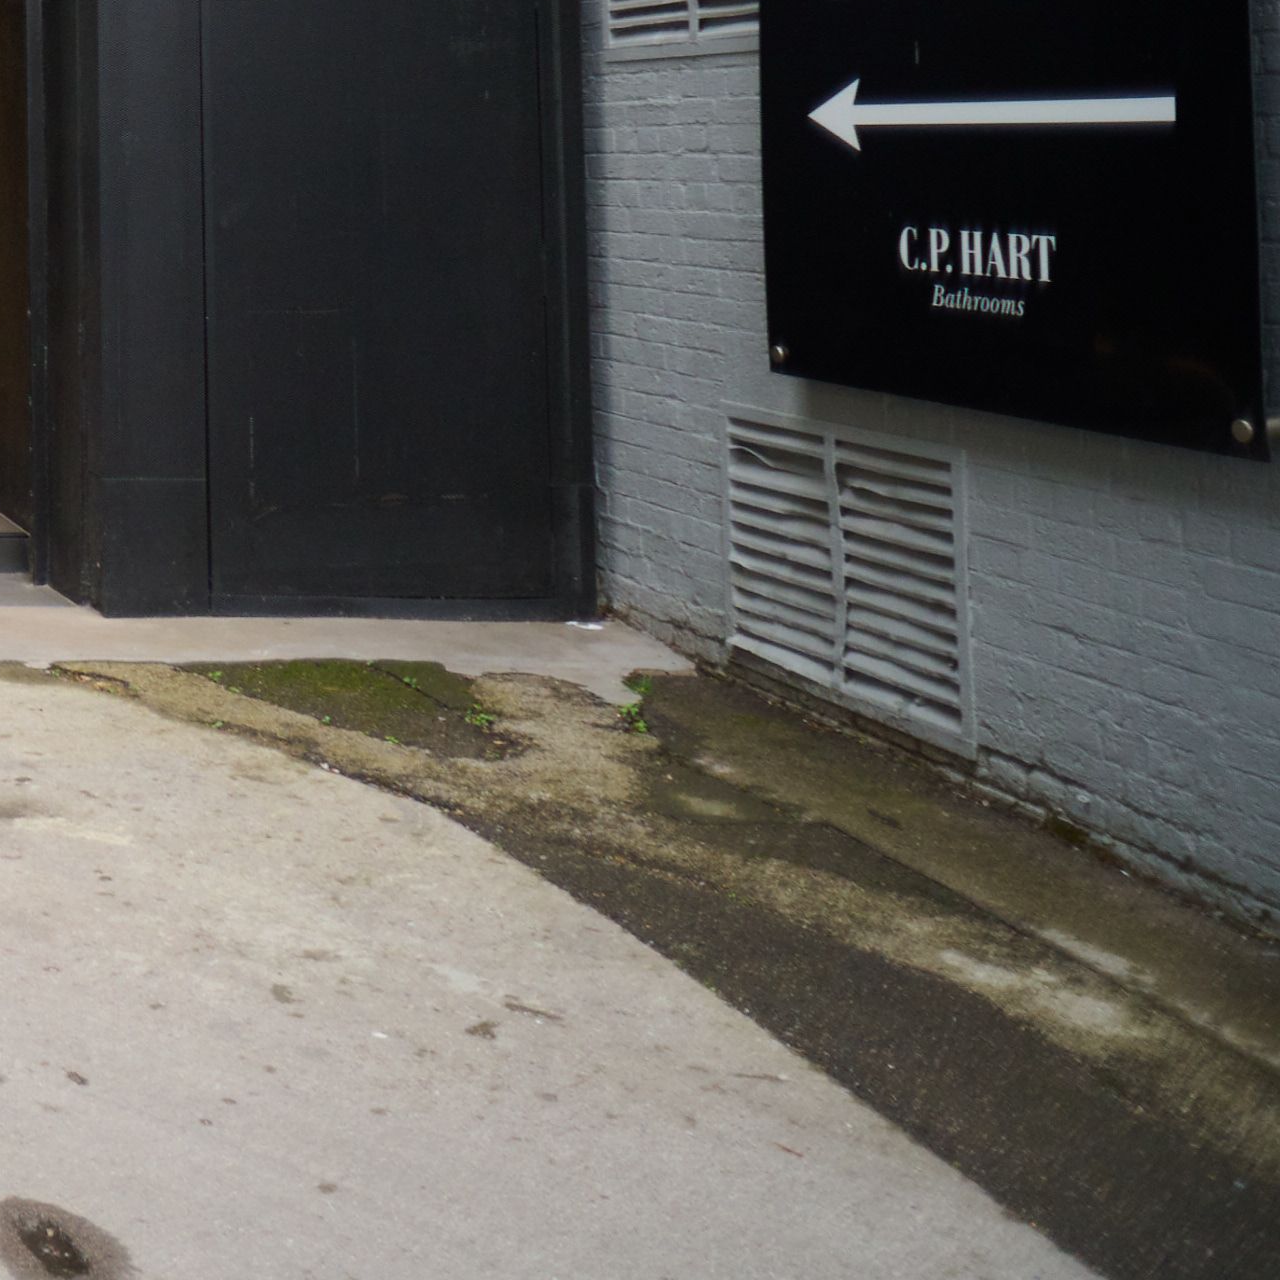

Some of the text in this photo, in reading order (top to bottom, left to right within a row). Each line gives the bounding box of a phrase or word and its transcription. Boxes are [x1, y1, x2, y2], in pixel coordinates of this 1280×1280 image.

[899, 226, 1056, 282] C.P. HART
[932, 284, 1025, 317] Bathrooms
